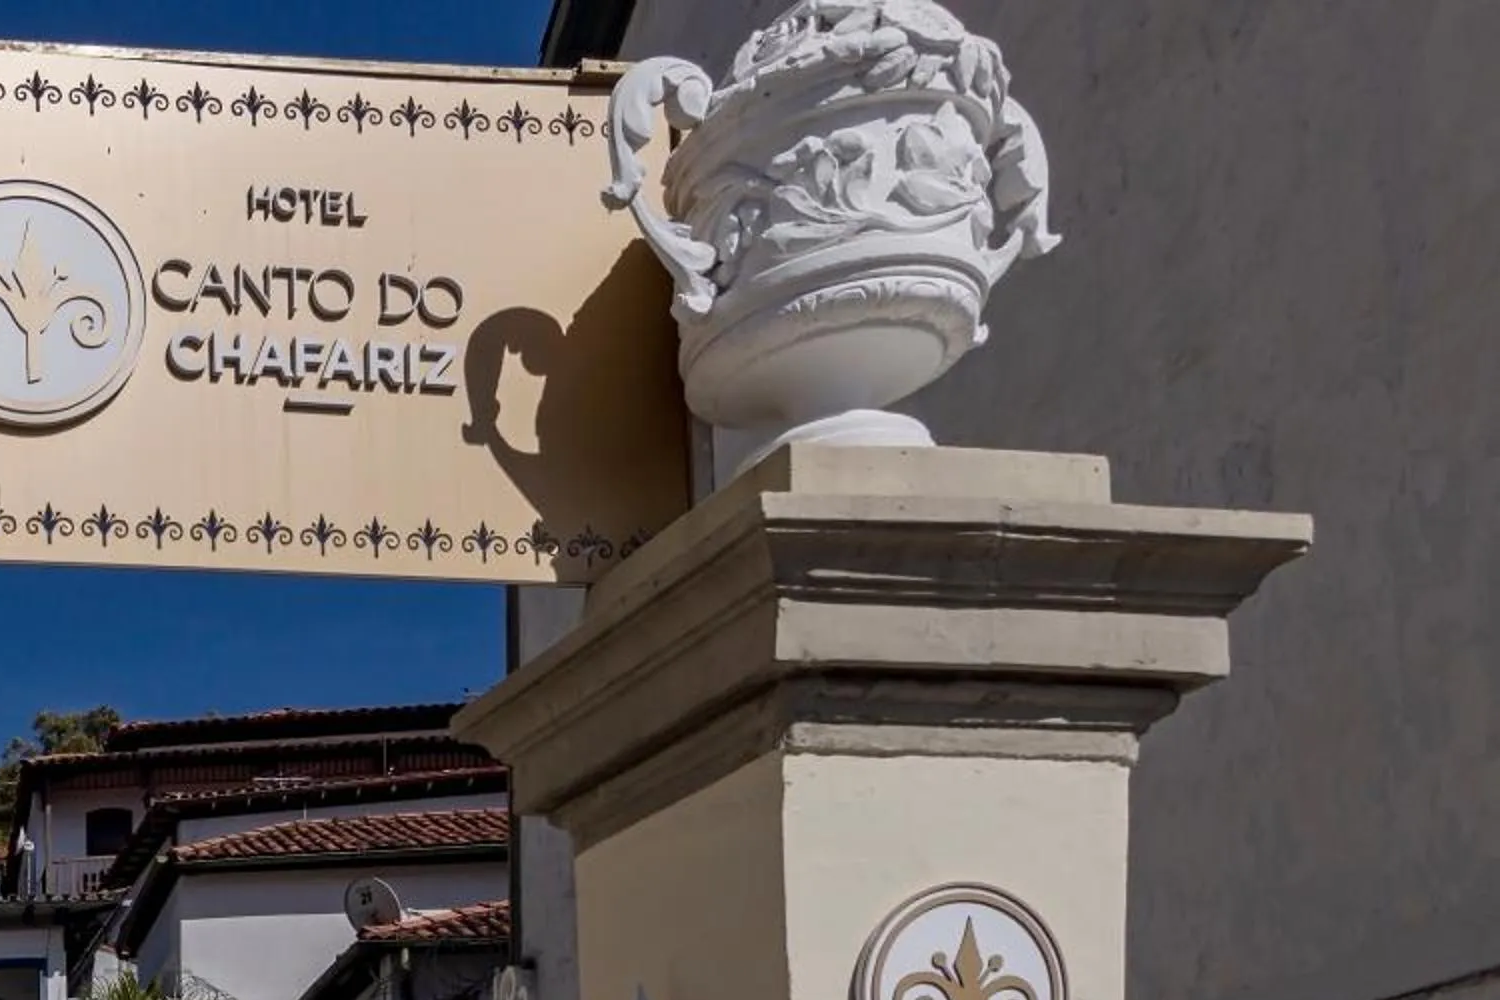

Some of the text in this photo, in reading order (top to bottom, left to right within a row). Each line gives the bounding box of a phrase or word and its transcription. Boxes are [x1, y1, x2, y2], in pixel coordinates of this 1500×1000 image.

[247, 185, 367, 228] HOTEL
[151, 259, 464, 329] CANTO DO
[164, 332, 459, 396] CHAFARIZ
